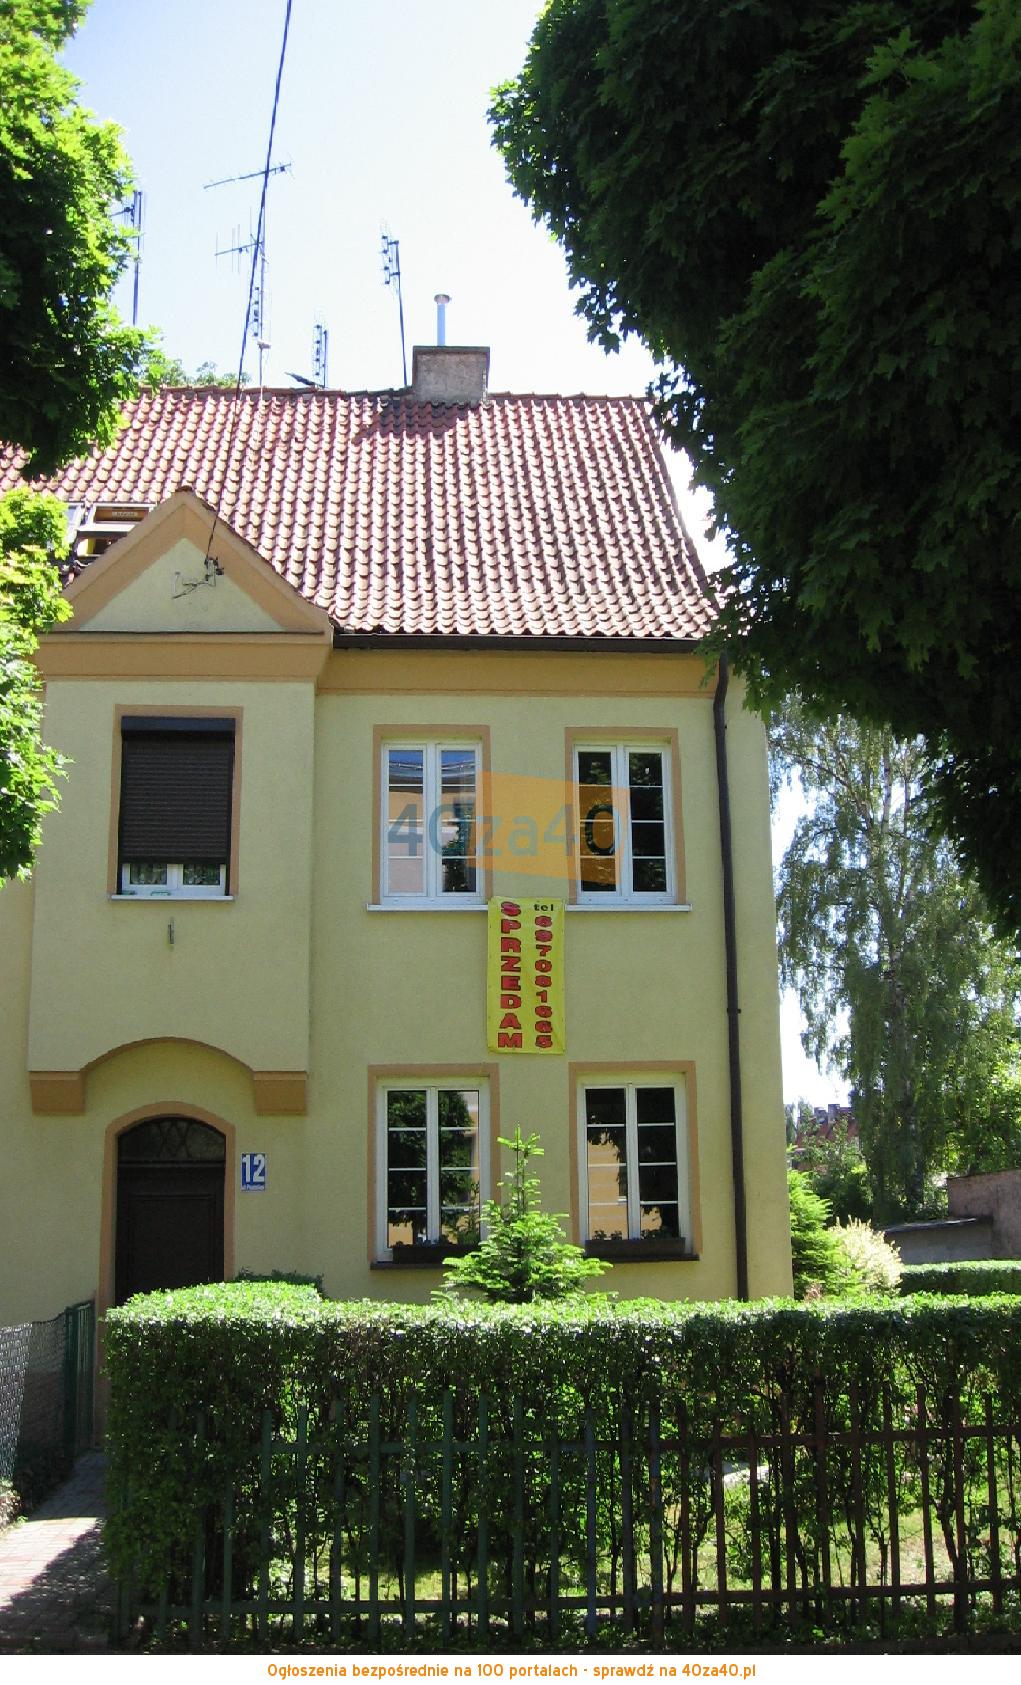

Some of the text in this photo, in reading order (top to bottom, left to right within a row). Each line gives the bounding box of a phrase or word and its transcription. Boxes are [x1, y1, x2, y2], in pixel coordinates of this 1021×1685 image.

[534, 903, 554, 912] tel
[498, 901, 523, 1049] SPRZEDAM
[242, 1153, 265, 1183] 12
